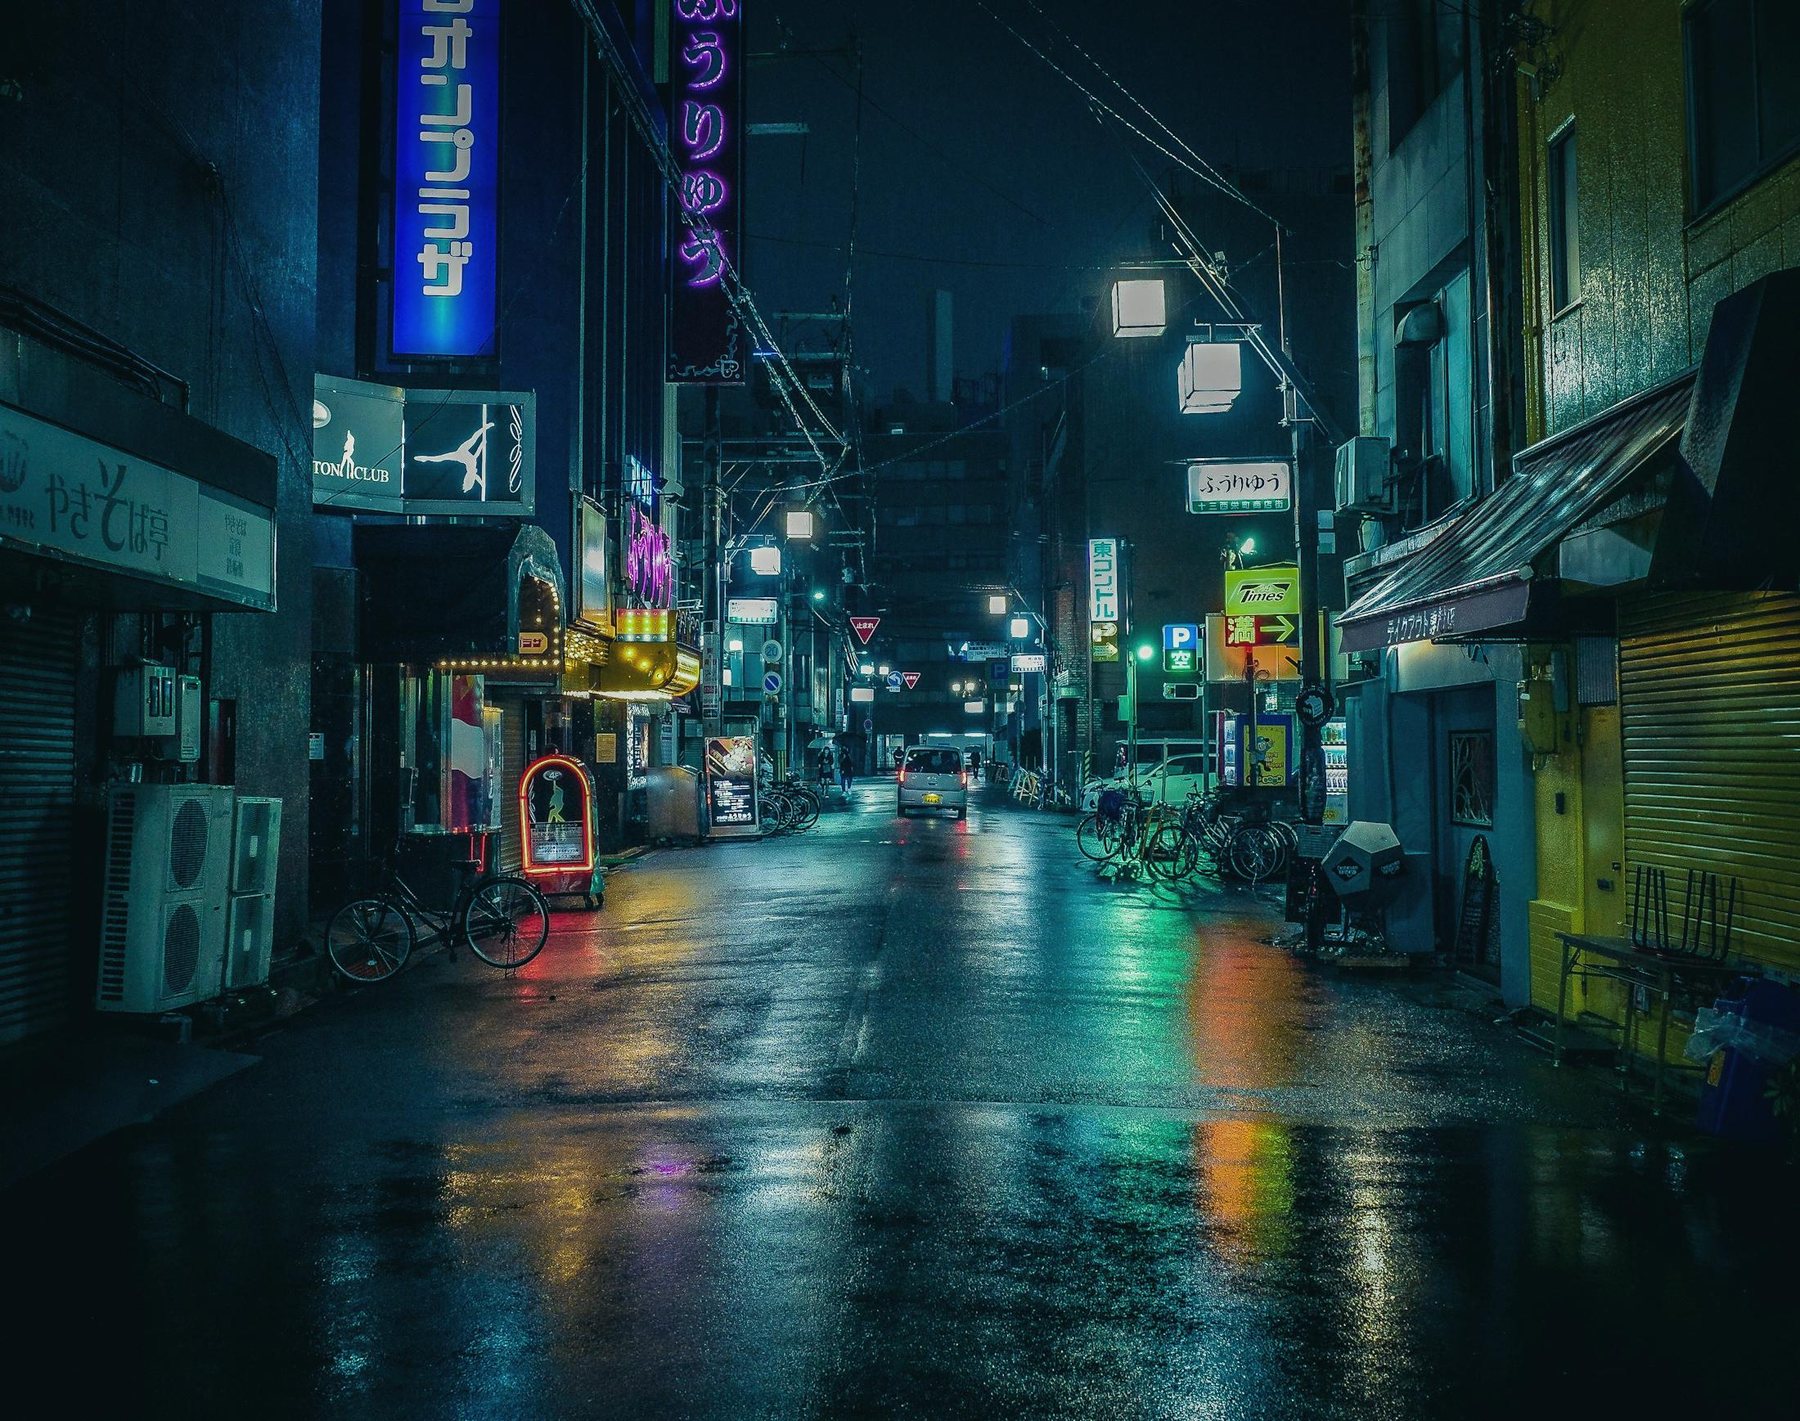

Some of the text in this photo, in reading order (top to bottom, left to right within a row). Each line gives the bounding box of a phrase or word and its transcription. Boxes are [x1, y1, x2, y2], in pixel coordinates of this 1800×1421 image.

[354, 466, 389, 482] CLUB
[44, 457, 169, 561] やきそば亭
[1197, 500, 1284, 511] 十三西栄町商店街
[1239, 583, 1291, 604] Times
[1172, 627, 1191, 648] P
[1227, 616, 1256, 644] 満
[767, 645, 779, 657] 20
[1170, 650, 1191, 670] 空
